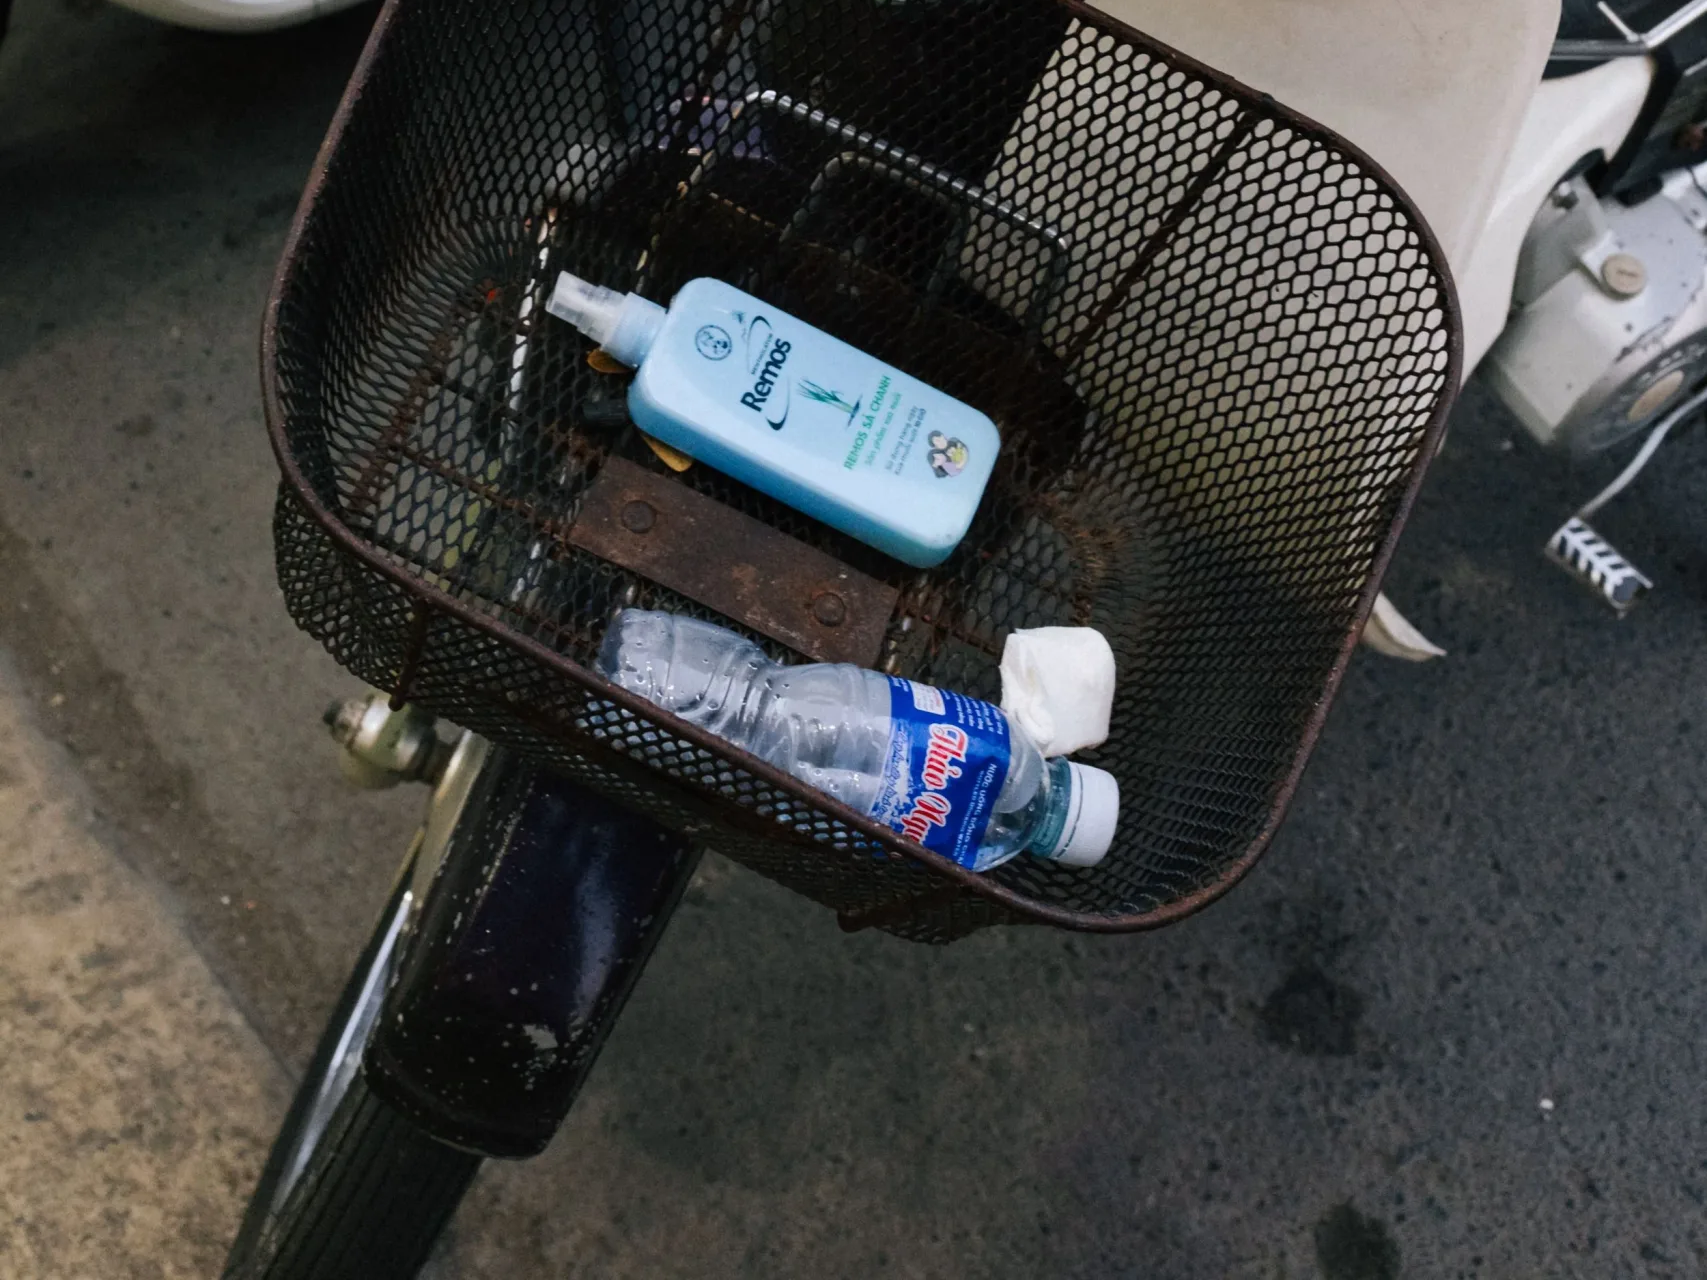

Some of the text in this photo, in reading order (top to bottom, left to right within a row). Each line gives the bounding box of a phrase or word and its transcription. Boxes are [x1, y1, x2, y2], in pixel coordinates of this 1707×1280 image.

[740, 337, 792, 413] Remos
[844, 431, 868, 469] REMOS
[870, 374, 891, 412] CHANH
[922, 723, 968, 791] Thảo
